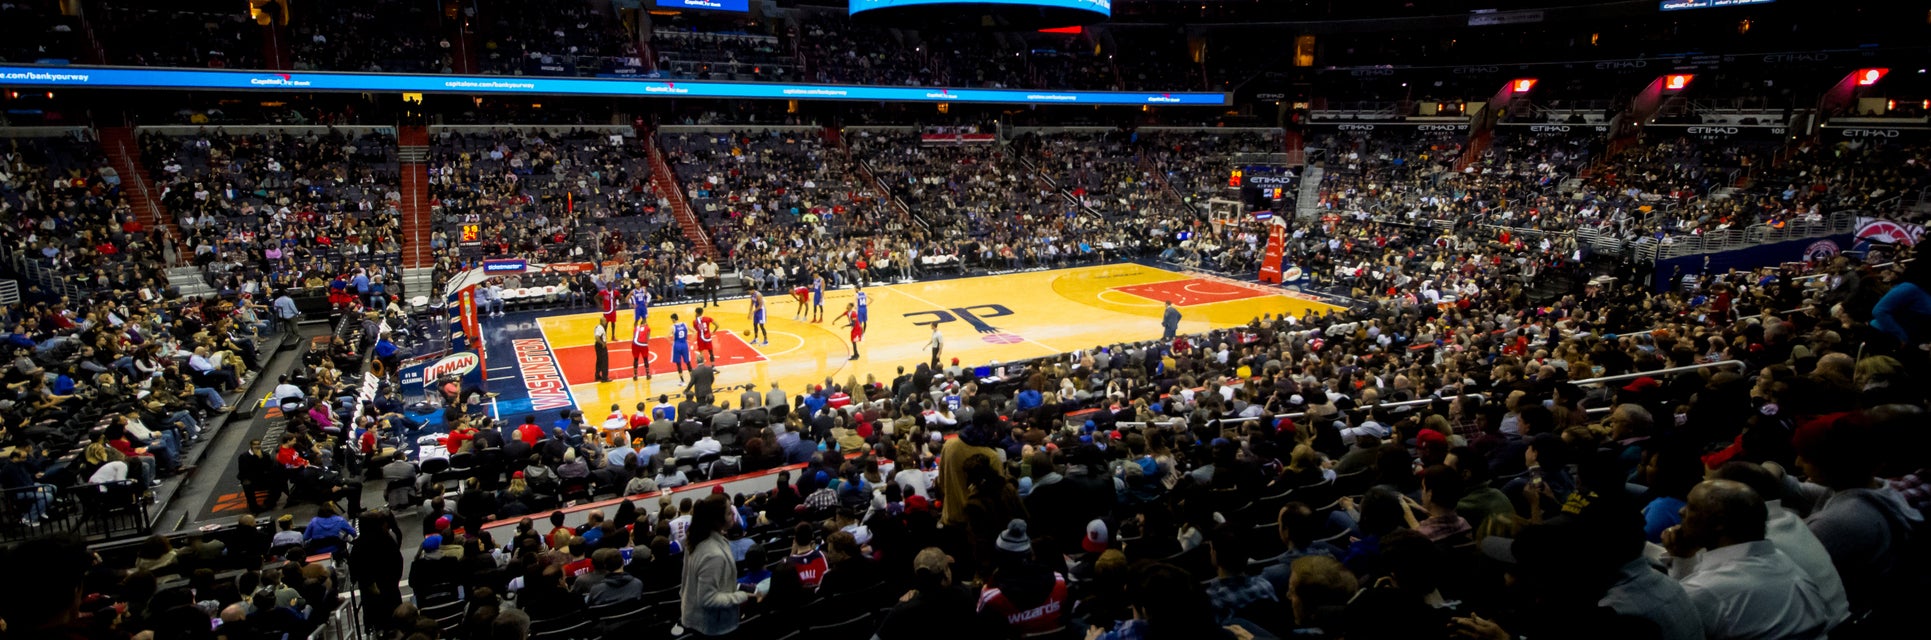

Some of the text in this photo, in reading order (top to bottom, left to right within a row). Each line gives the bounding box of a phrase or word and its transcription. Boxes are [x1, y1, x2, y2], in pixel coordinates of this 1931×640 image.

[1452, 65, 1500, 74] ETIHAD
[1595, 60, 1648, 70] ETIHAD
[1687, 126, 1739, 134] ETIHAD
[1841, 128, 1900, 138] ETIHAD
[512, 338, 572, 411] WASHINGTON
[1008, 598, 1060, 624] wizards
